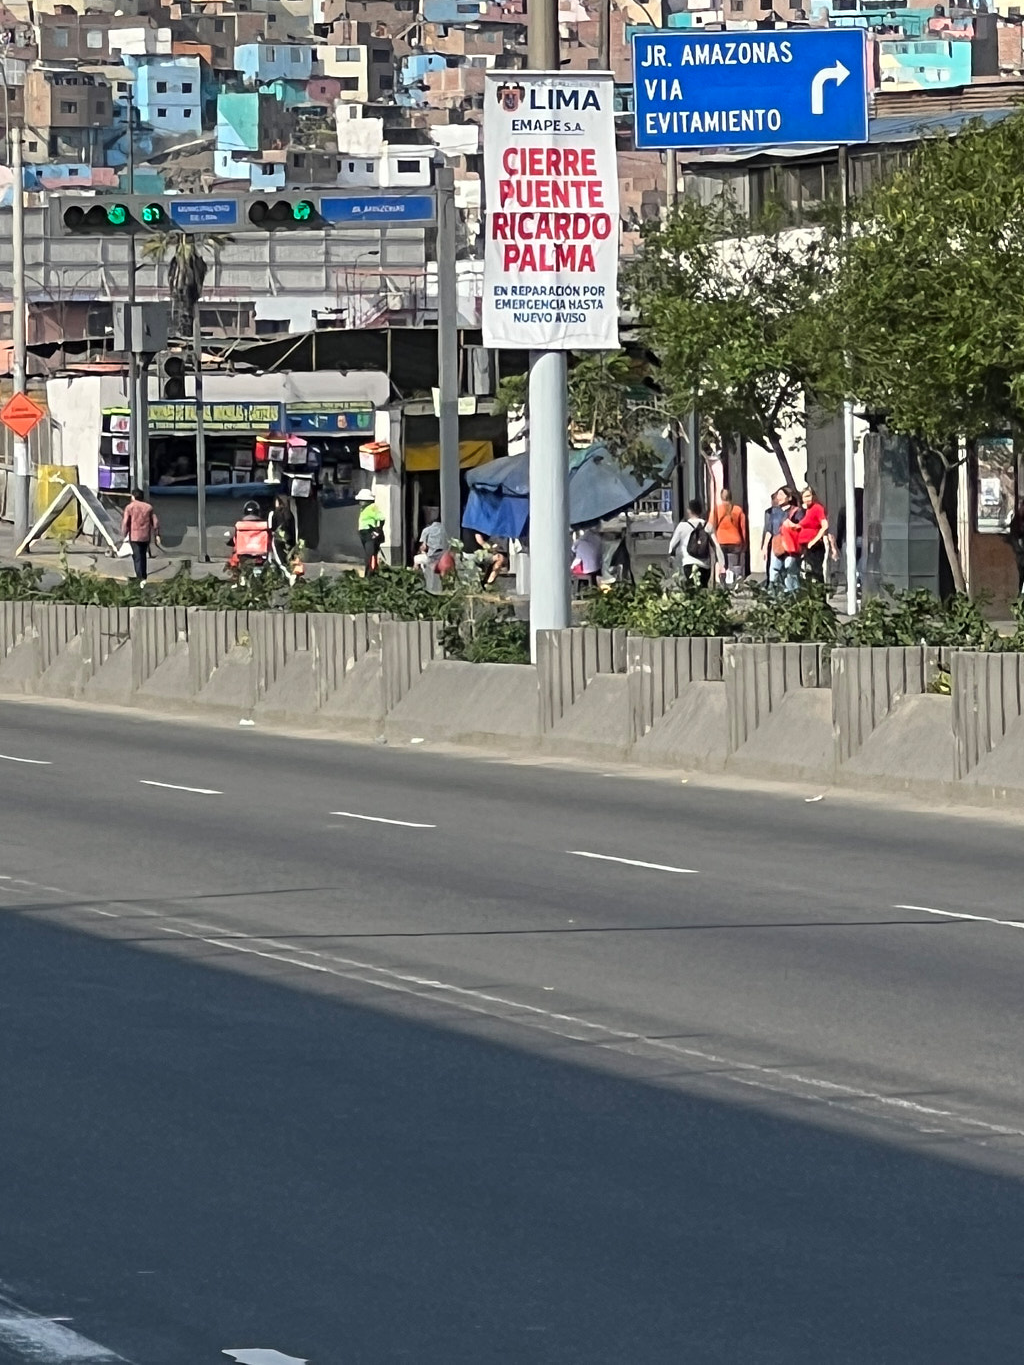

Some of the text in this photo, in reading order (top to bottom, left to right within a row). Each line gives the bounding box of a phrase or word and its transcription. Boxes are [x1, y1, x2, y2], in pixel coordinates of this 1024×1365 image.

[641, 41, 793, 68] JR. AMAZONAS
[530, 89, 601, 111] LIMA
[644, 78, 683, 101] VIA
[512, 119, 561, 132] EMAPE
[645, 109, 782, 135] EVITAMIENTO
[502, 147, 597, 176] CIERRE
[499, 180, 604, 208] PUENTE
[492, 212, 612, 240] RICARDO
[503, 244, 596, 273] PALMA
[494, 285, 508, 297] EN
[583, 286, 605, 297] POR
[495, 299, 604, 310] EMERGENCIA HASTA
[513, 312, 587, 323] NUEVO AVISO
